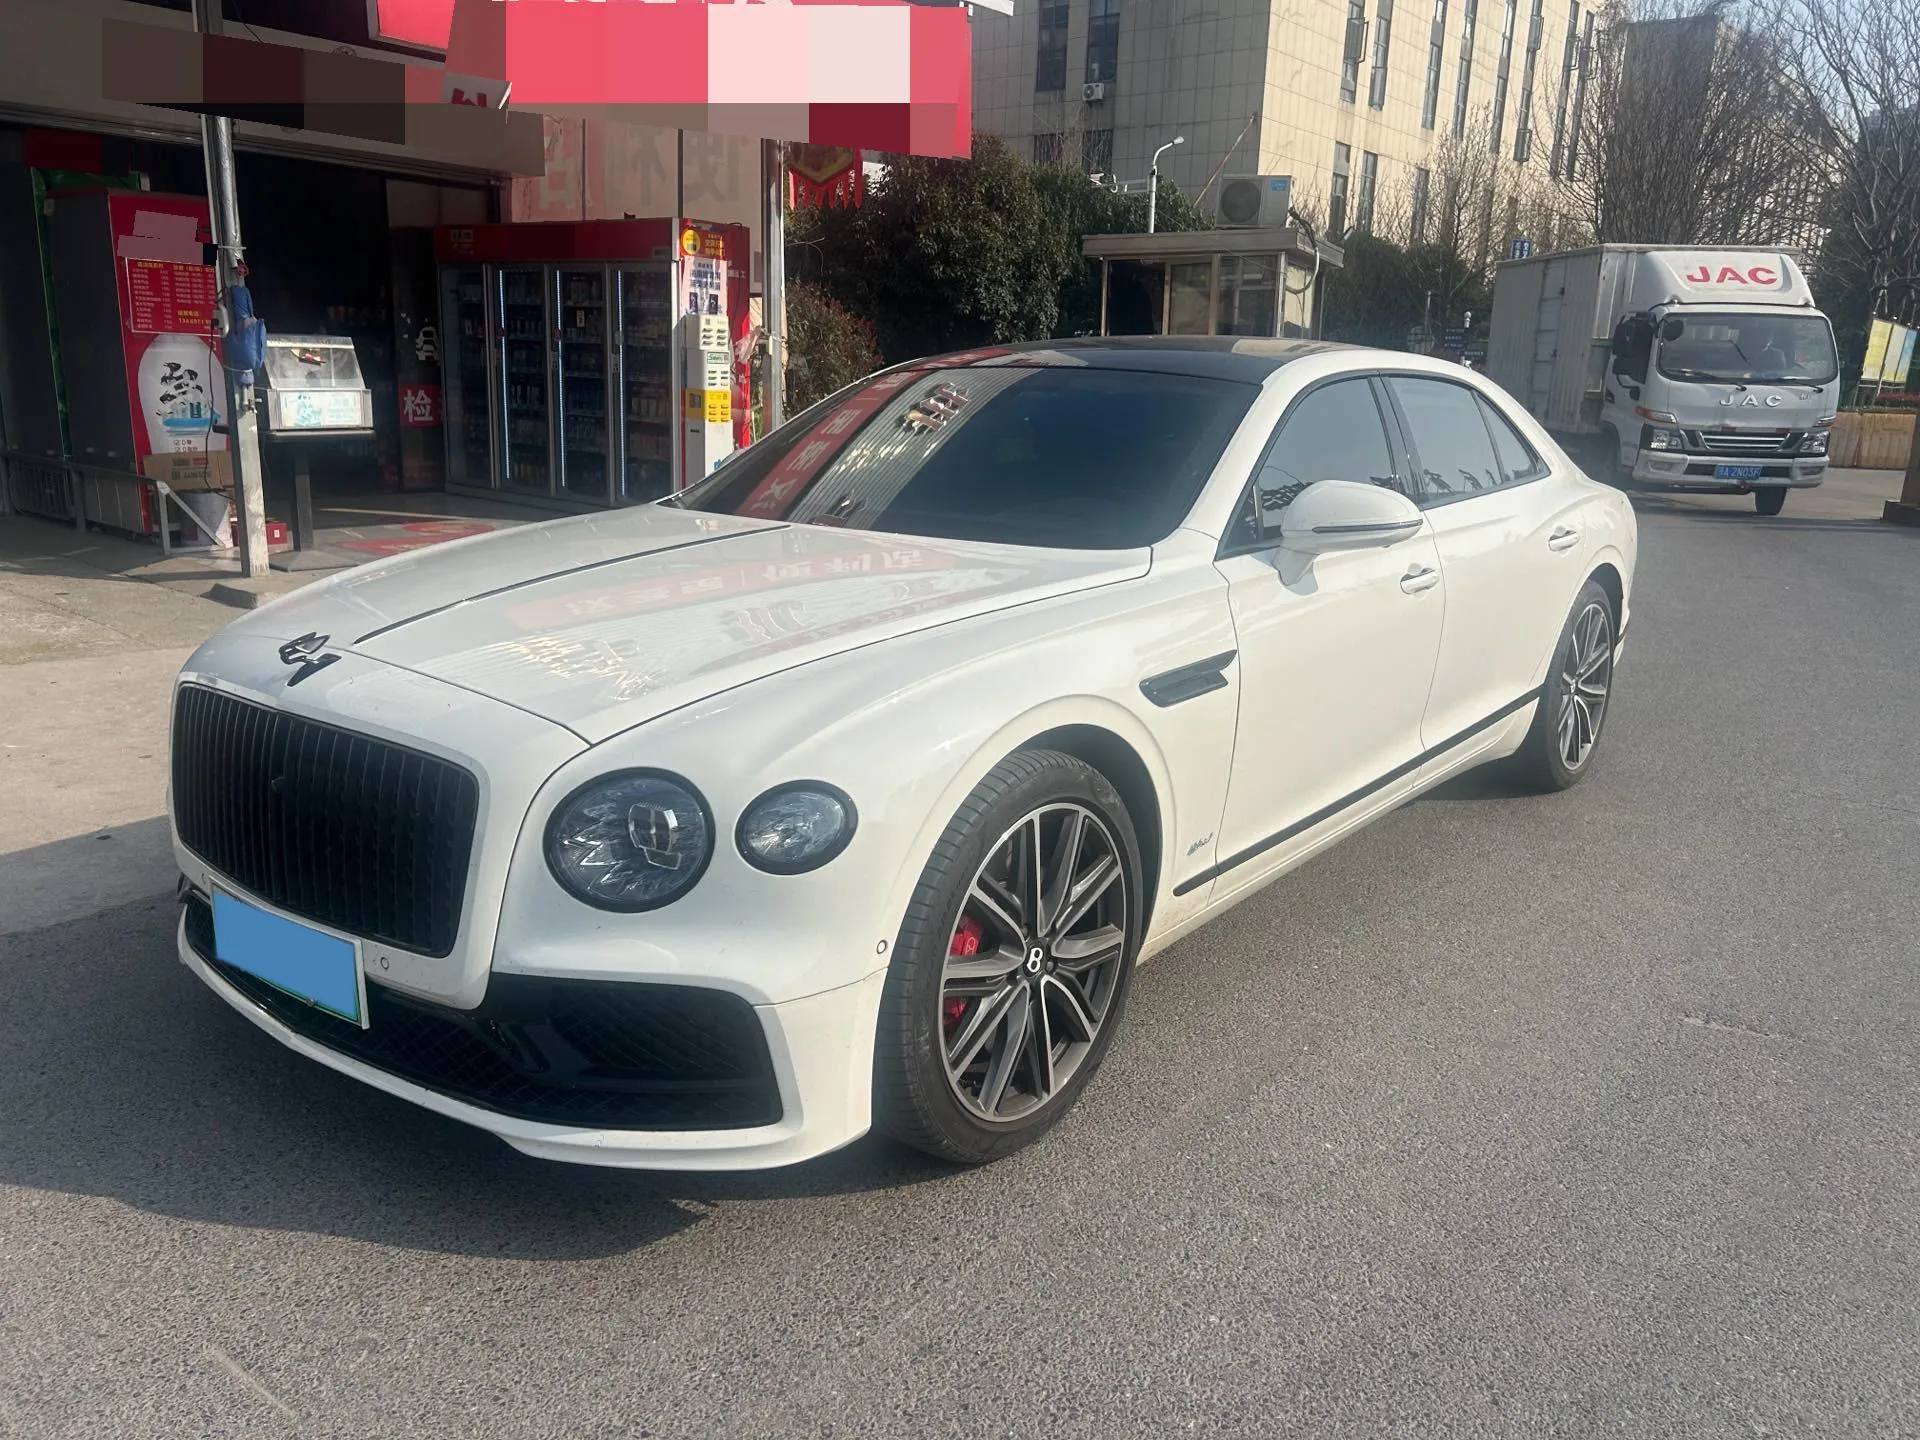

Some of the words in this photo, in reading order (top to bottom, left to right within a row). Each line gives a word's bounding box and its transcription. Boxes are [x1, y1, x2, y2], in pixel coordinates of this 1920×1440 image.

[1686, 266, 1777, 285] JAC
[403, 389, 434, 424] 检
[1720, 394, 1782, 407] JAC
